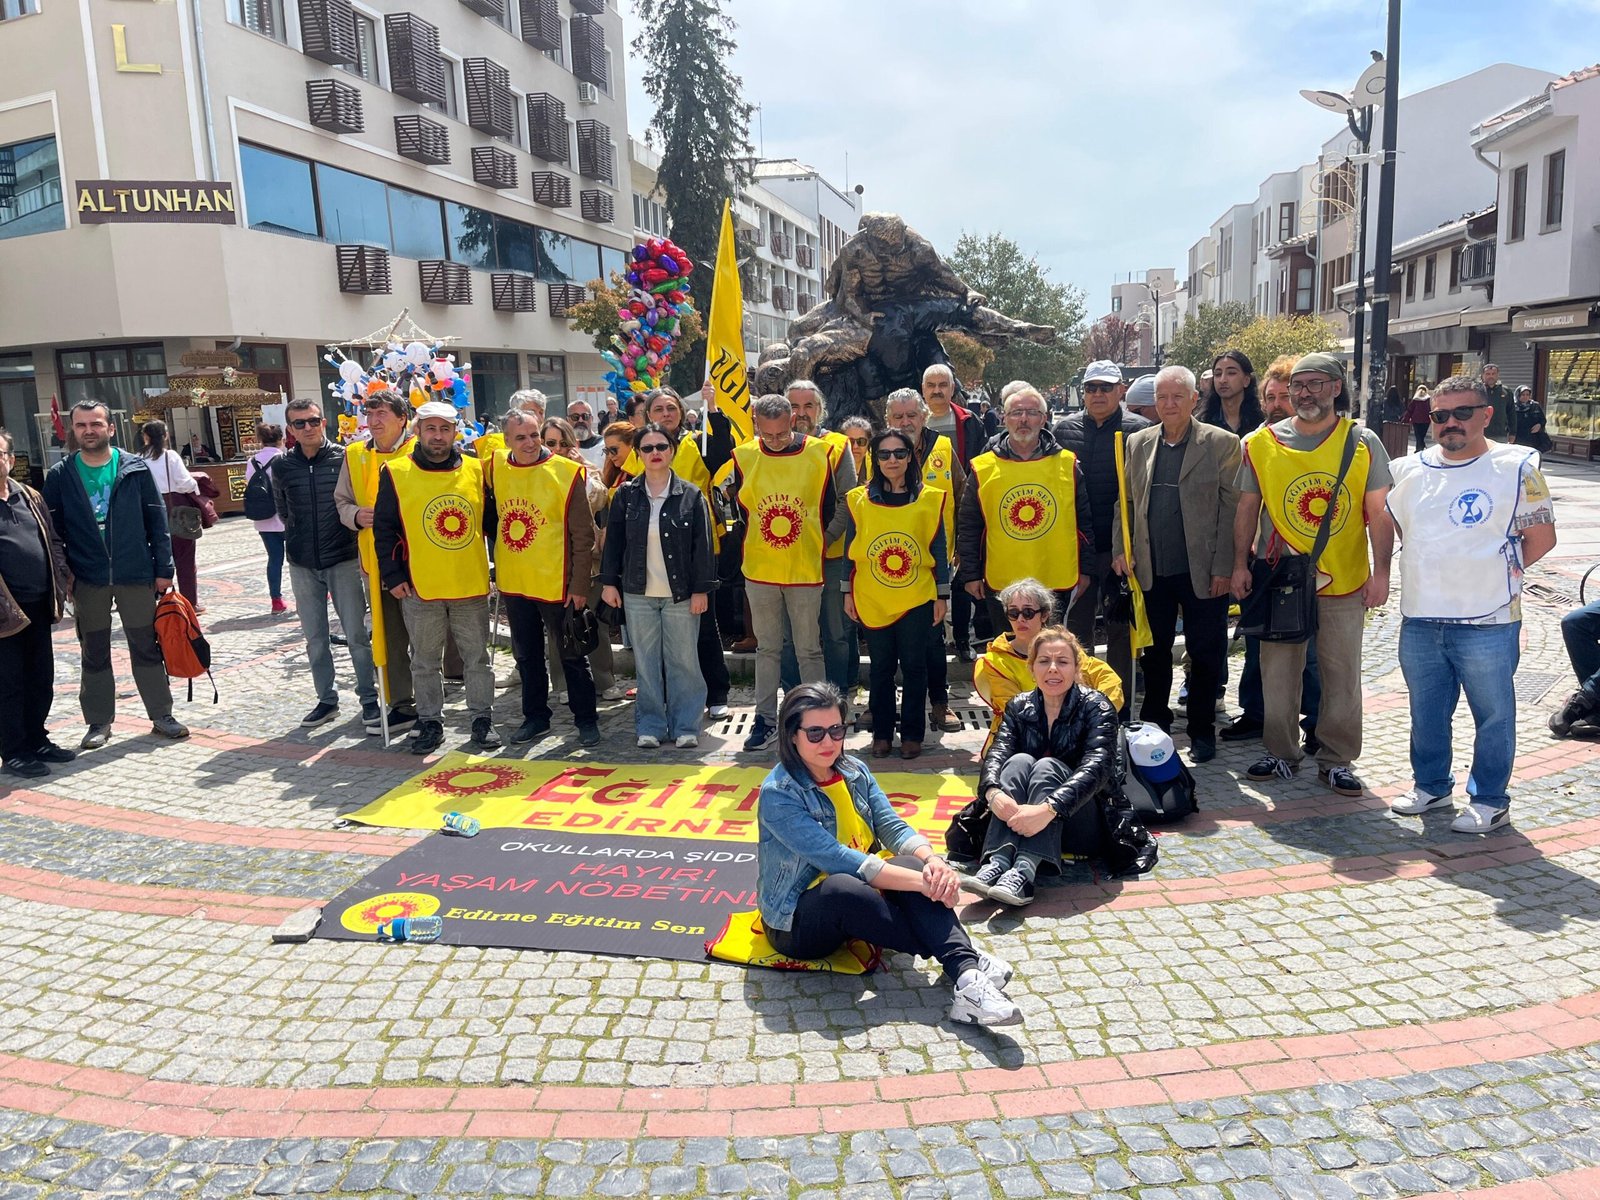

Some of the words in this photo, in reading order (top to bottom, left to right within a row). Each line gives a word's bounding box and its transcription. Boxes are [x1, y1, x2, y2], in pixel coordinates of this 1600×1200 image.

[78, 188, 235, 213] ALTUNHAN
[459, 502, 472, 516] SEN
[1037, 491, 1052, 507] SEN
[530, 504, 548, 526] SEN
[522, 766, 760, 812] EĞİTİ
[886, 792, 977, 820] SE
[522, 811, 756, 837] EDİRNE
[500, 841, 675, 861] OKULLARDA
[684, 850, 760, 863] ŞİDD
[396, 872, 538, 894] YAŞAM
[569, 863, 717, 882] HAYIR!
[444, 907, 538, 923] Edirne
[544, 913, 641, 931] Eğitim
[651, 920, 705, 936] Sen
